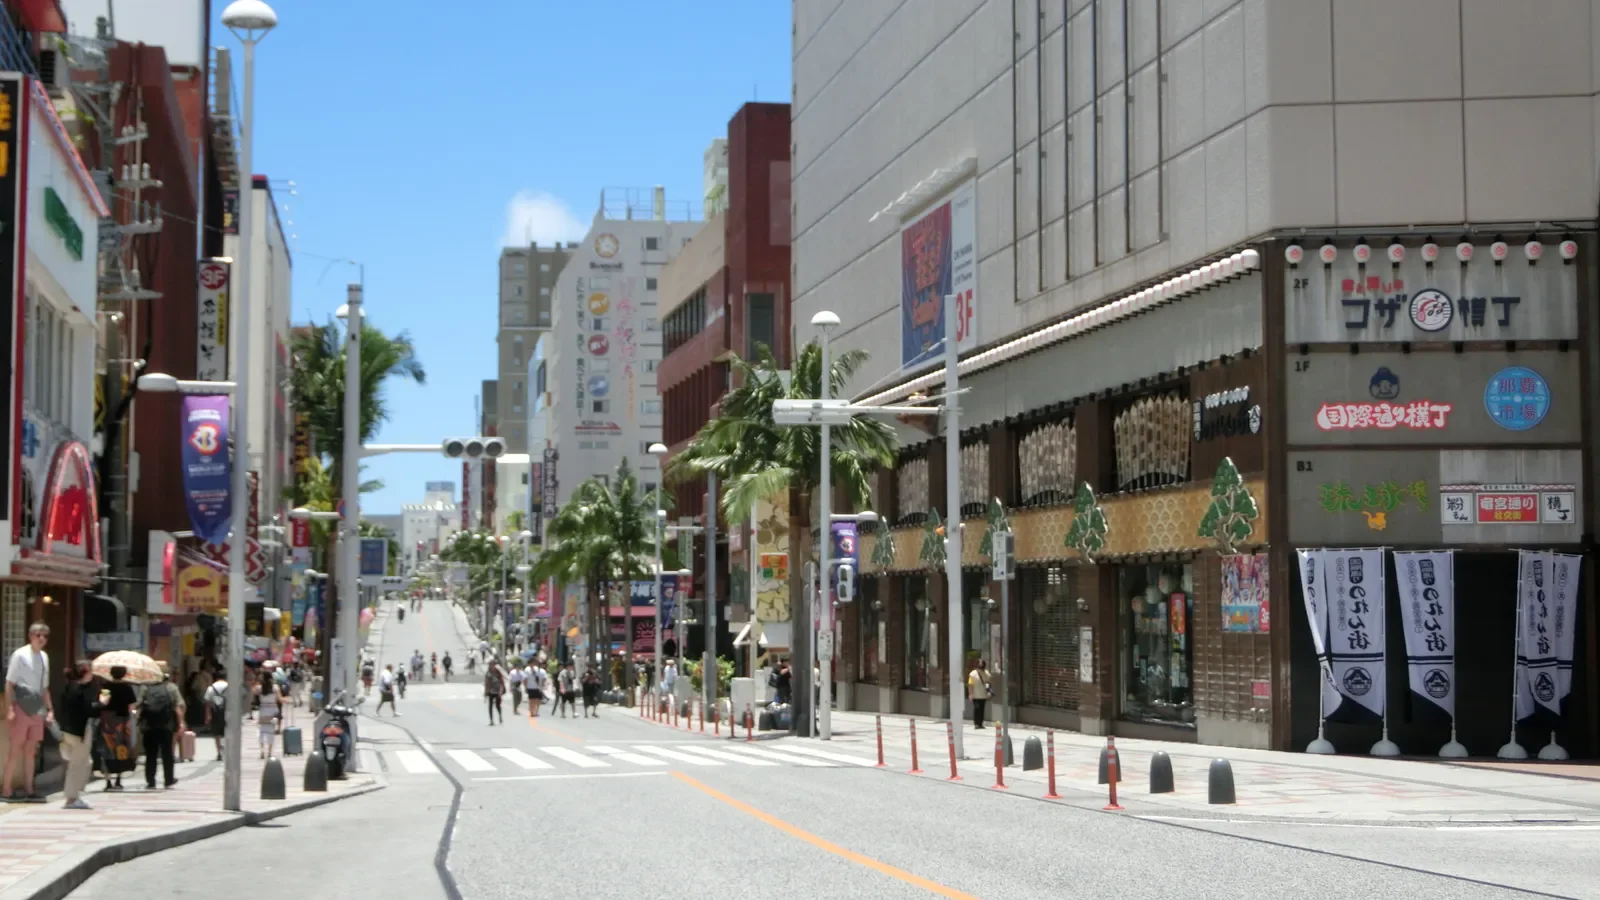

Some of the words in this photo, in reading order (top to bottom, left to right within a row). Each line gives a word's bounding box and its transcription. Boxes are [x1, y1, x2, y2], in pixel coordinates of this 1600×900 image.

[1294, 279, 1308, 289] 2F
[956, 289, 973, 342] 3F
[1342, 295, 1407, 328] コザ
[1295, 361, 1310, 372] 1F
[1499, 377, 1536, 394] 那覇
[1316, 401, 1451, 430] 国際通り横丁
[1499, 404, 1536, 421] 市場
[1297, 461, 1313, 472] B1
[1547, 495, 1570, 521] 横丁
